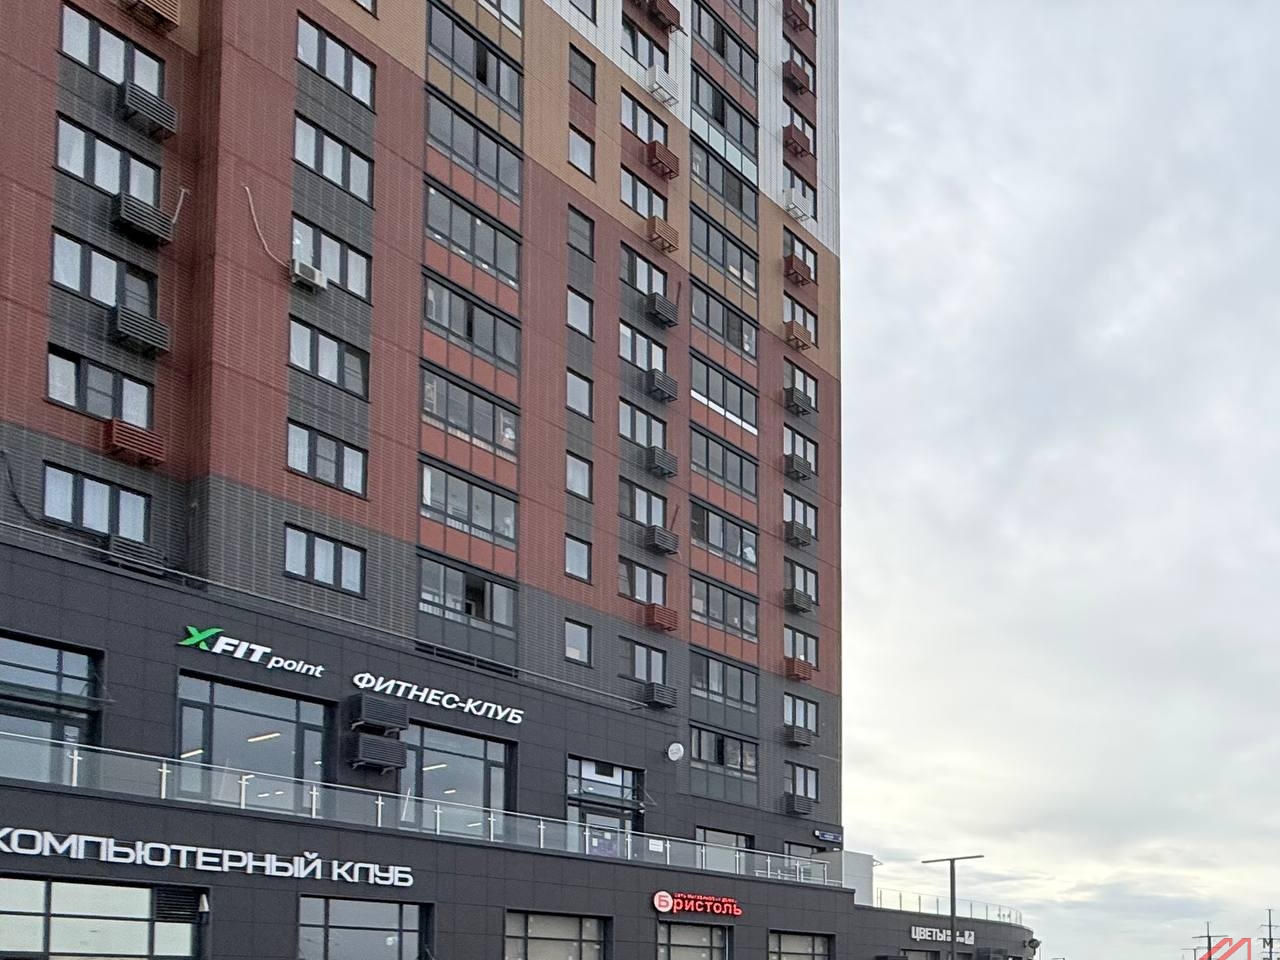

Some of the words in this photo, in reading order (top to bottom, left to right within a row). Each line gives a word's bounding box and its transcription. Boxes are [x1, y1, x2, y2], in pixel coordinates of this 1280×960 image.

[266, 655, 325, 678] point
[352, 672, 525, 725] ФИТНЕС-КЛУБ
[331, 860, 414, 887] КЛУБ
[911, 926, 946, 942] ЦВЕТЫ
